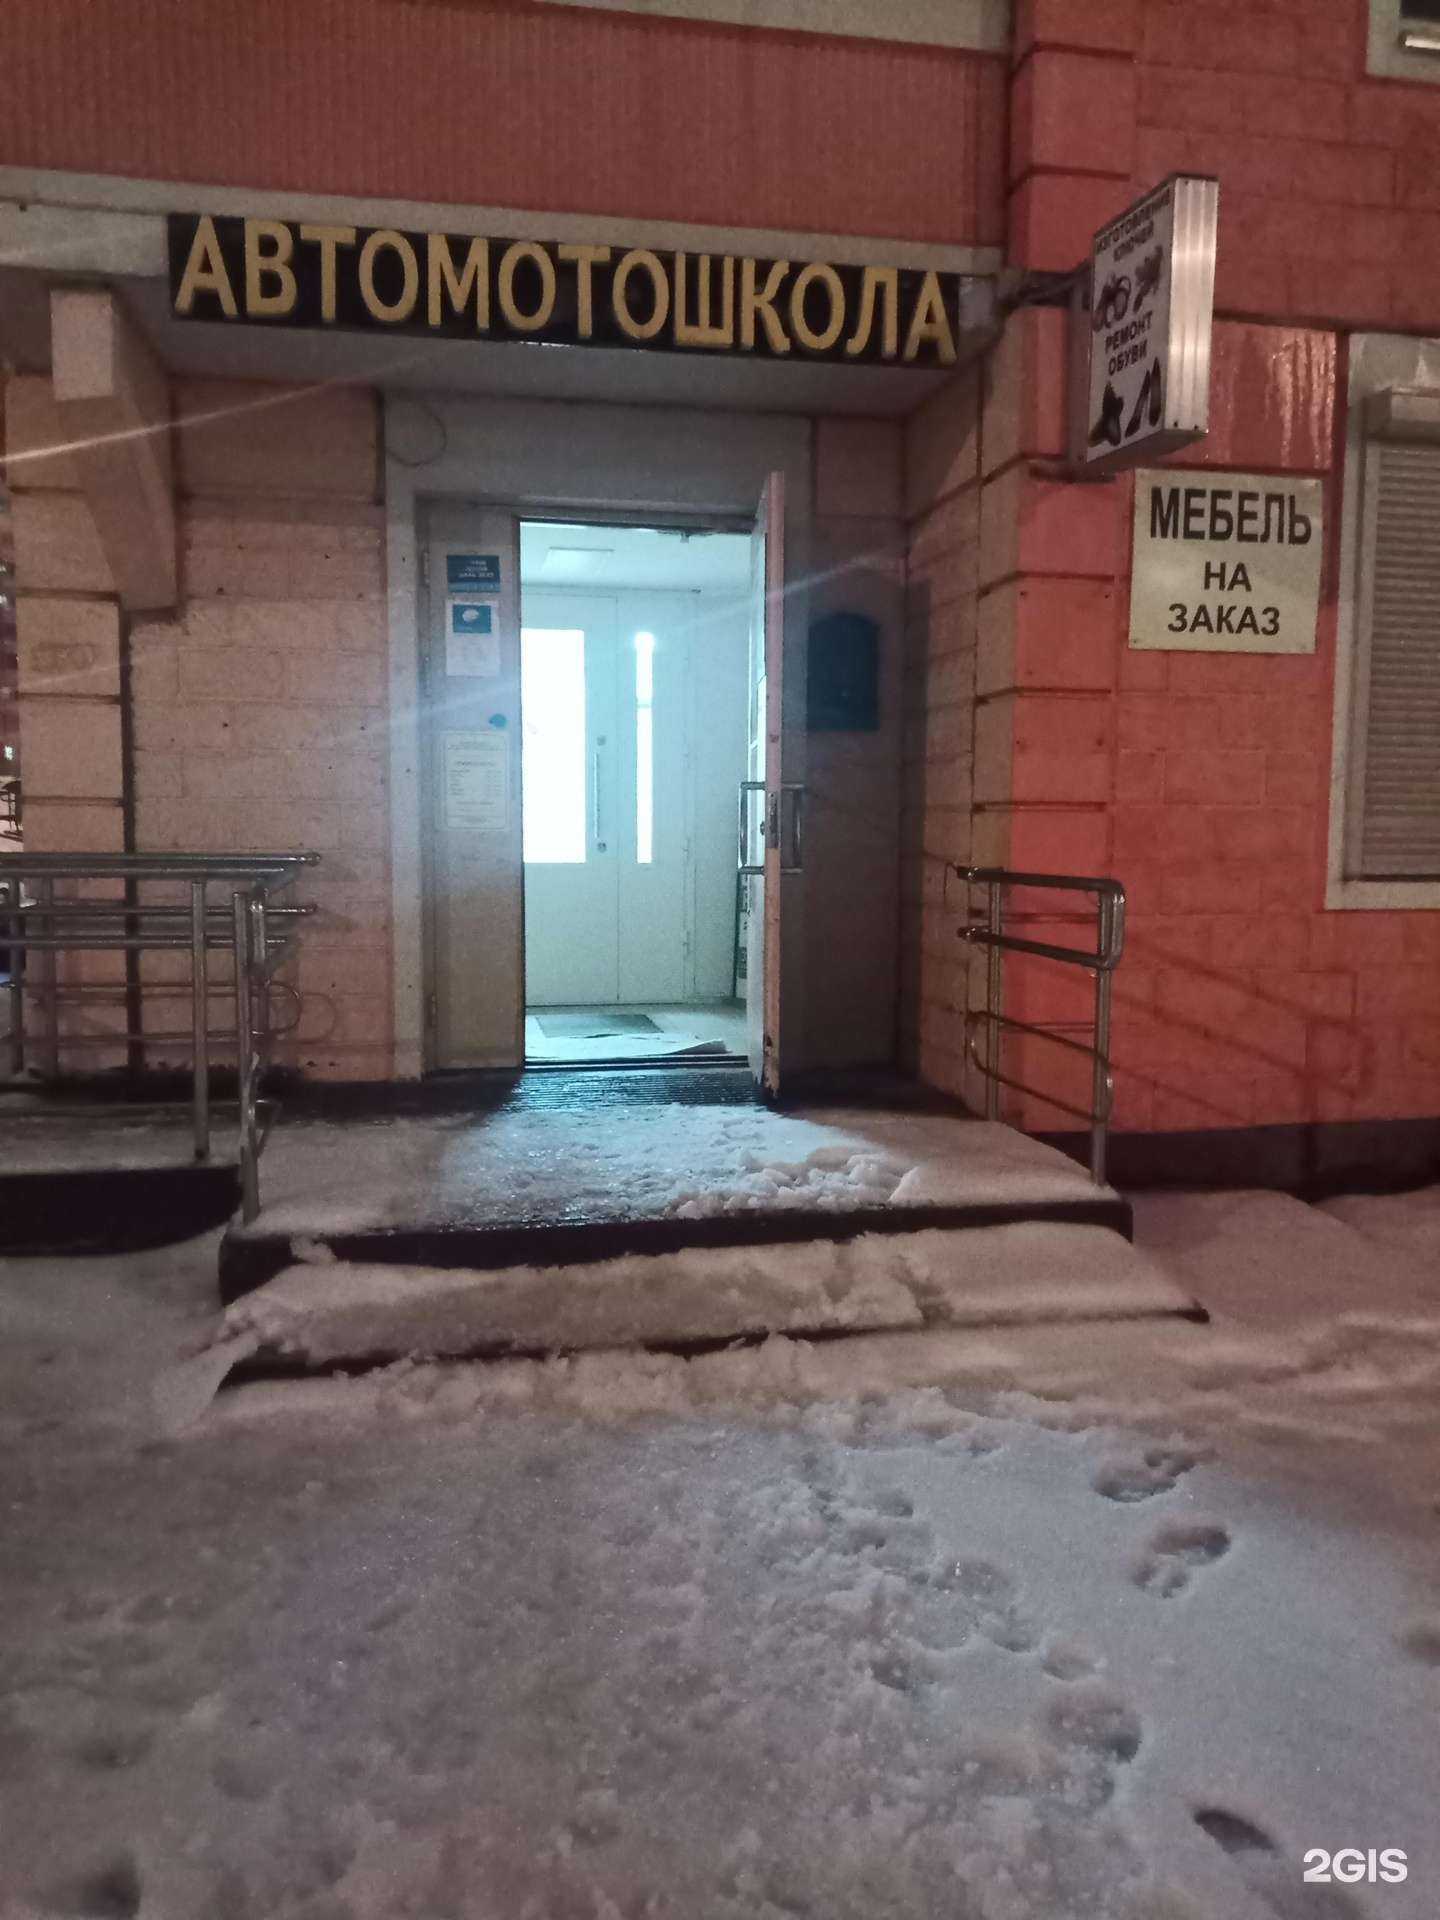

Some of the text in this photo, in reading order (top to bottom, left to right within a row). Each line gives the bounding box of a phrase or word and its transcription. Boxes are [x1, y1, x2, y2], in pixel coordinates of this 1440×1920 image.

[174, 215, 957, 365] АВТОМОТОШКОЛА
[1105, 310, 1153, 354] РЕМОНТ
[1108, 338, 1148, 376] ОБУВИ
[1150, 486, 1312, 545] МЕБЕЛЬ
[1203, 560, 1252, 592] НА
[1167, 603, 1280, 636] ЗАКАЗ
